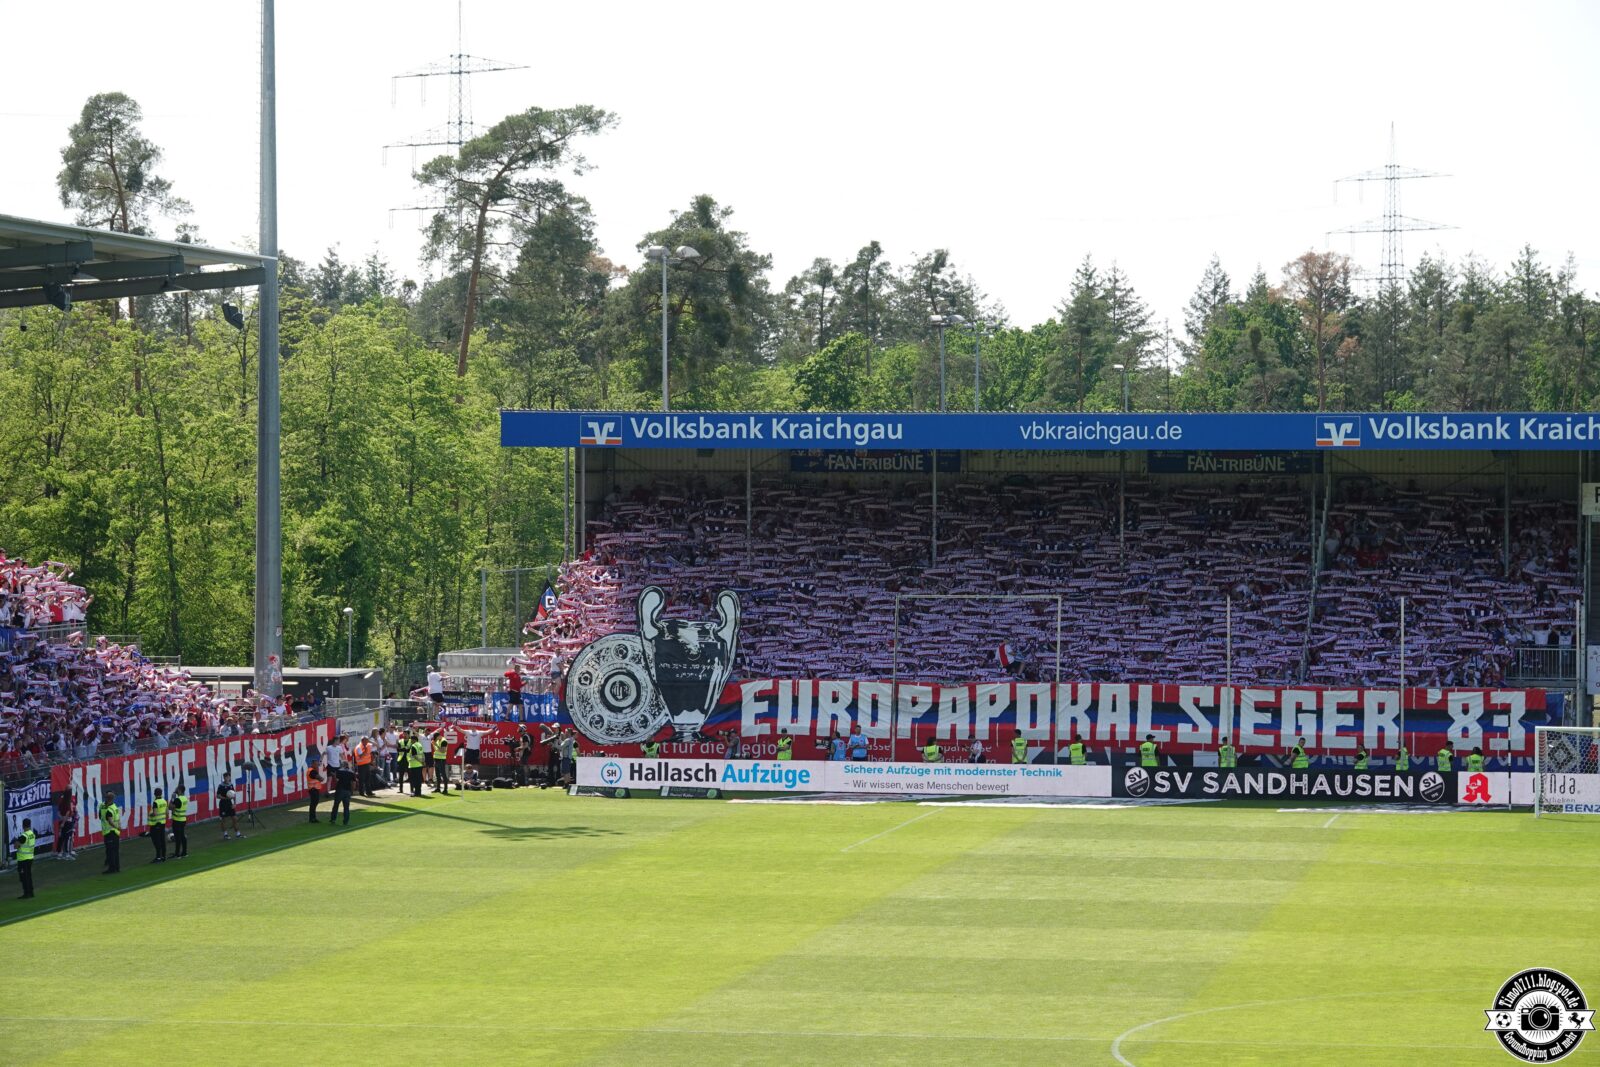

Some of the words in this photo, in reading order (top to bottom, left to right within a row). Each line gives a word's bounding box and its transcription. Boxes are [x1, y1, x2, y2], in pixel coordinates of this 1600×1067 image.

[630, 417, 764, 440] Volksbank
[772, 417, 903, 446] Kraichgau
[1020, 421, 1183, 445] vbkraichgau.de
[1369, 416, 1511, 440] Volksbank
[828, 453, 924, 471] FAN-TRIBÜNE
[1187, 454, 1286, 472] FAN-TRIBÜNE
[740, 679, 1400, 750] EUROPAPOKALSIEGER
[206, 730, 310, 812] MEISTER
[606, 769, 617, 777] SH
[630, 761, 717, 783] Hallasch
[721, 763, 811, 788] Aufzüge
[844, 765, 884, 774] Sichere
[886, 765, 931, 776] Aufzüge
[934, 766, 952, 775] mit
[954, 766, 1018, 777] modernster
[1020, 767, 1063, 777] Technik
[1128, 769, 1142, 783] SV
[1423, 774, 1437, 787] SV
[853, 780, 867, 788] Wir
[870, 780, 904, 790] wissen,
[906, 781, 924, 790] was
[927, 781, 974, 790] Menschen
[976, 782, 1009, 792] bewegt
[1154, 771, 1193, 793] SV
[1202, 771, 1414, 797] SANDHAUSEN
